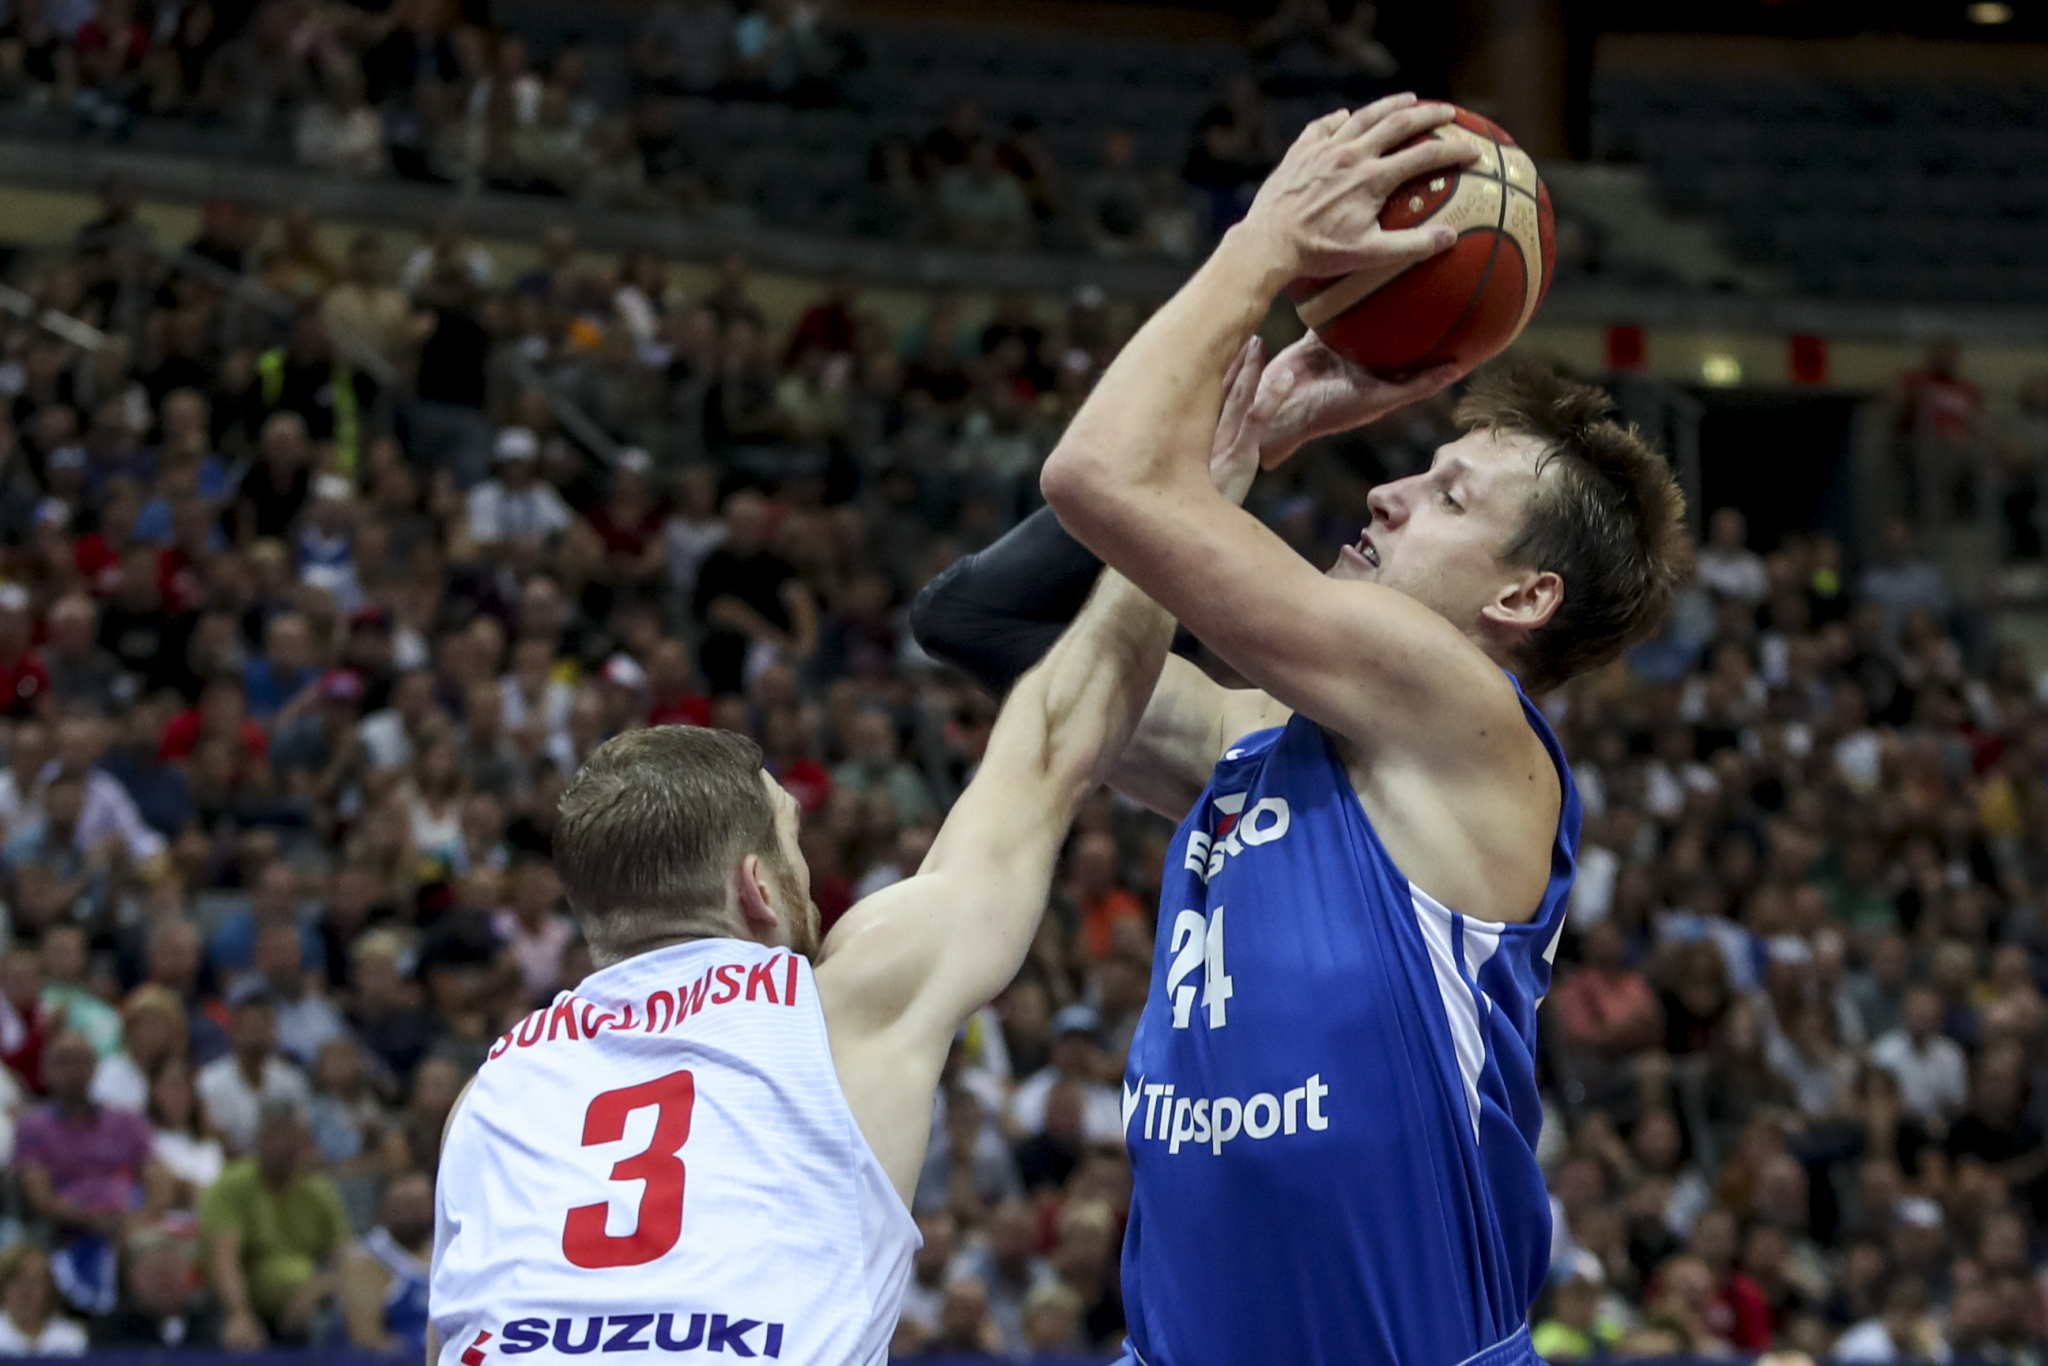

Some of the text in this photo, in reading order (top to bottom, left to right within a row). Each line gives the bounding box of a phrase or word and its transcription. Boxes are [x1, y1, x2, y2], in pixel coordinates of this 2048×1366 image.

[1167, 906, 1232, 1029] 24
[1144, 1073, 1329, 1156] Tipsport
[562, 1070, 695, 1268] 3
[500, 1313, 783, 1358] SUZUKI
